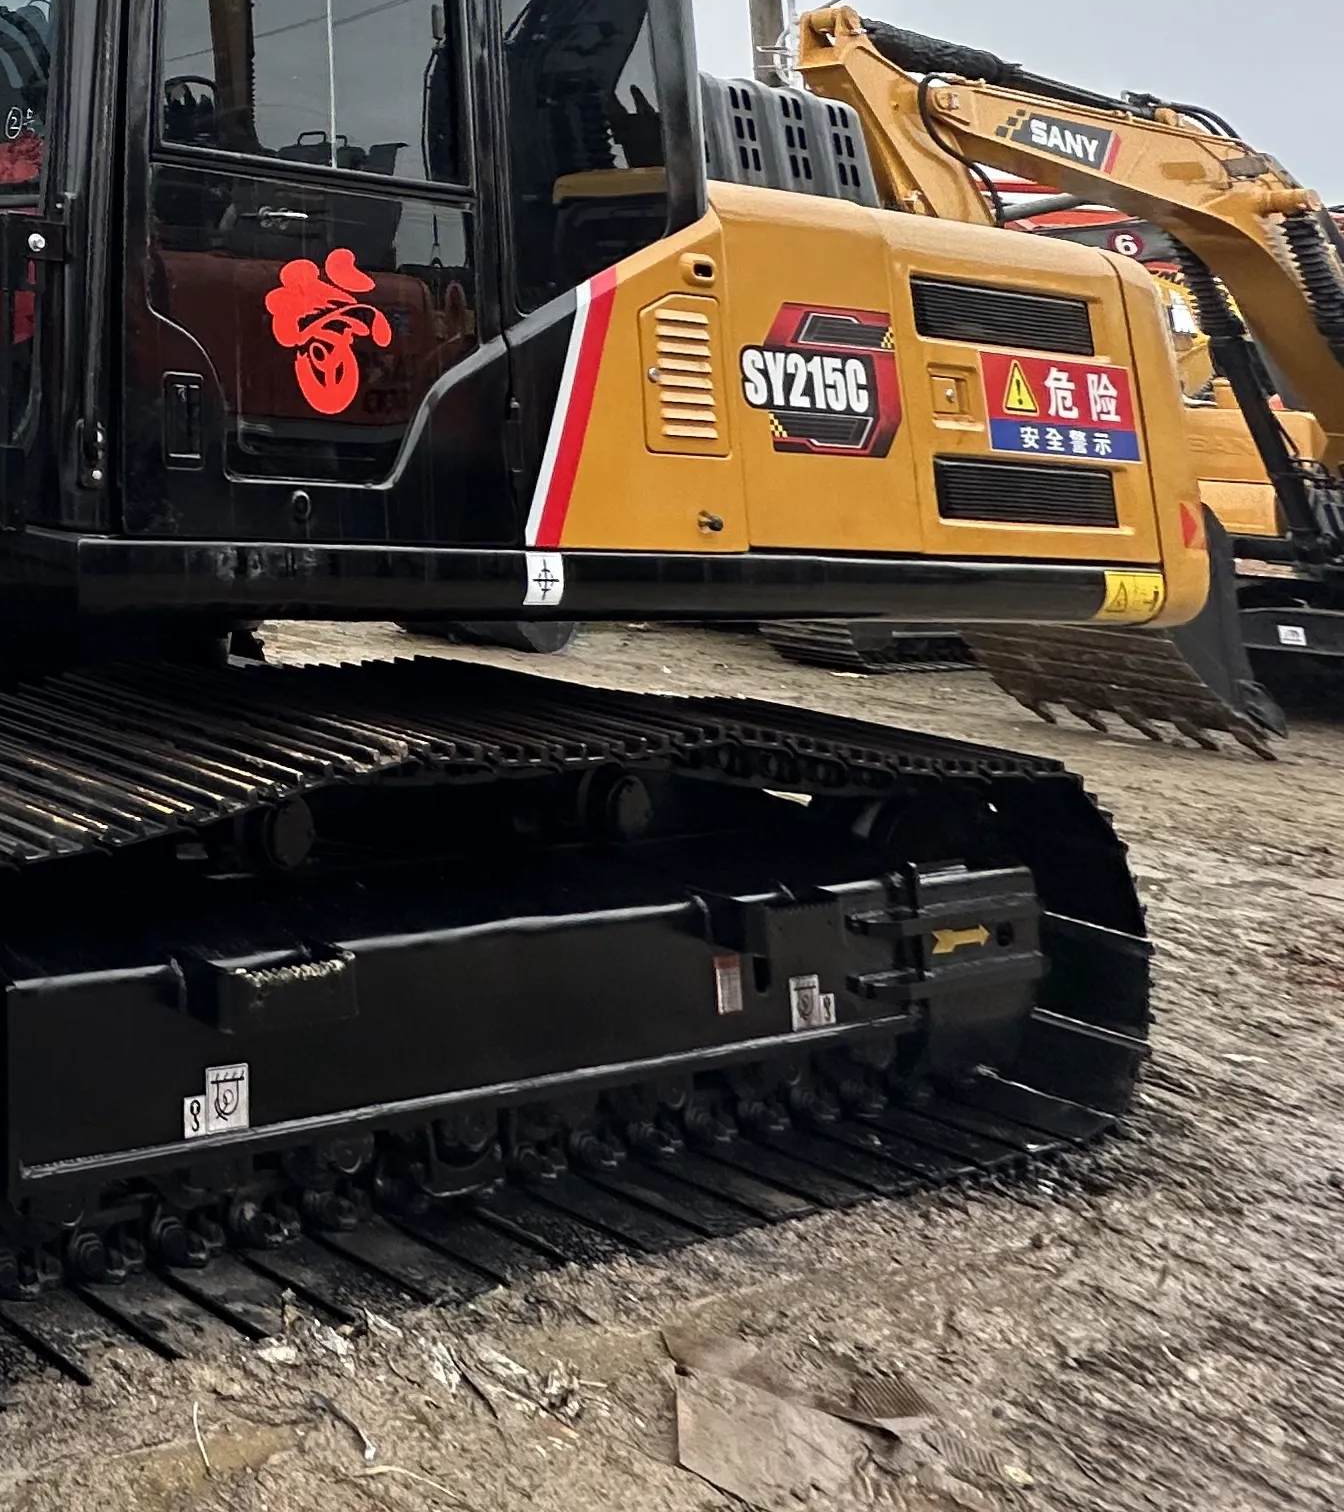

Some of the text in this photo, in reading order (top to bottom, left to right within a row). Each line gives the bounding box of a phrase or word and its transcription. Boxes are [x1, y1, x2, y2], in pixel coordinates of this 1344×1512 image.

[1030, 118, 1099, 162] SANY
[1114, 234, 1139, 256] 6
[741, 348, 869, 413] SY215C
[1044, 366, 1121, 423] 危险
[1020, 426, 1112, 456] 安全警示
